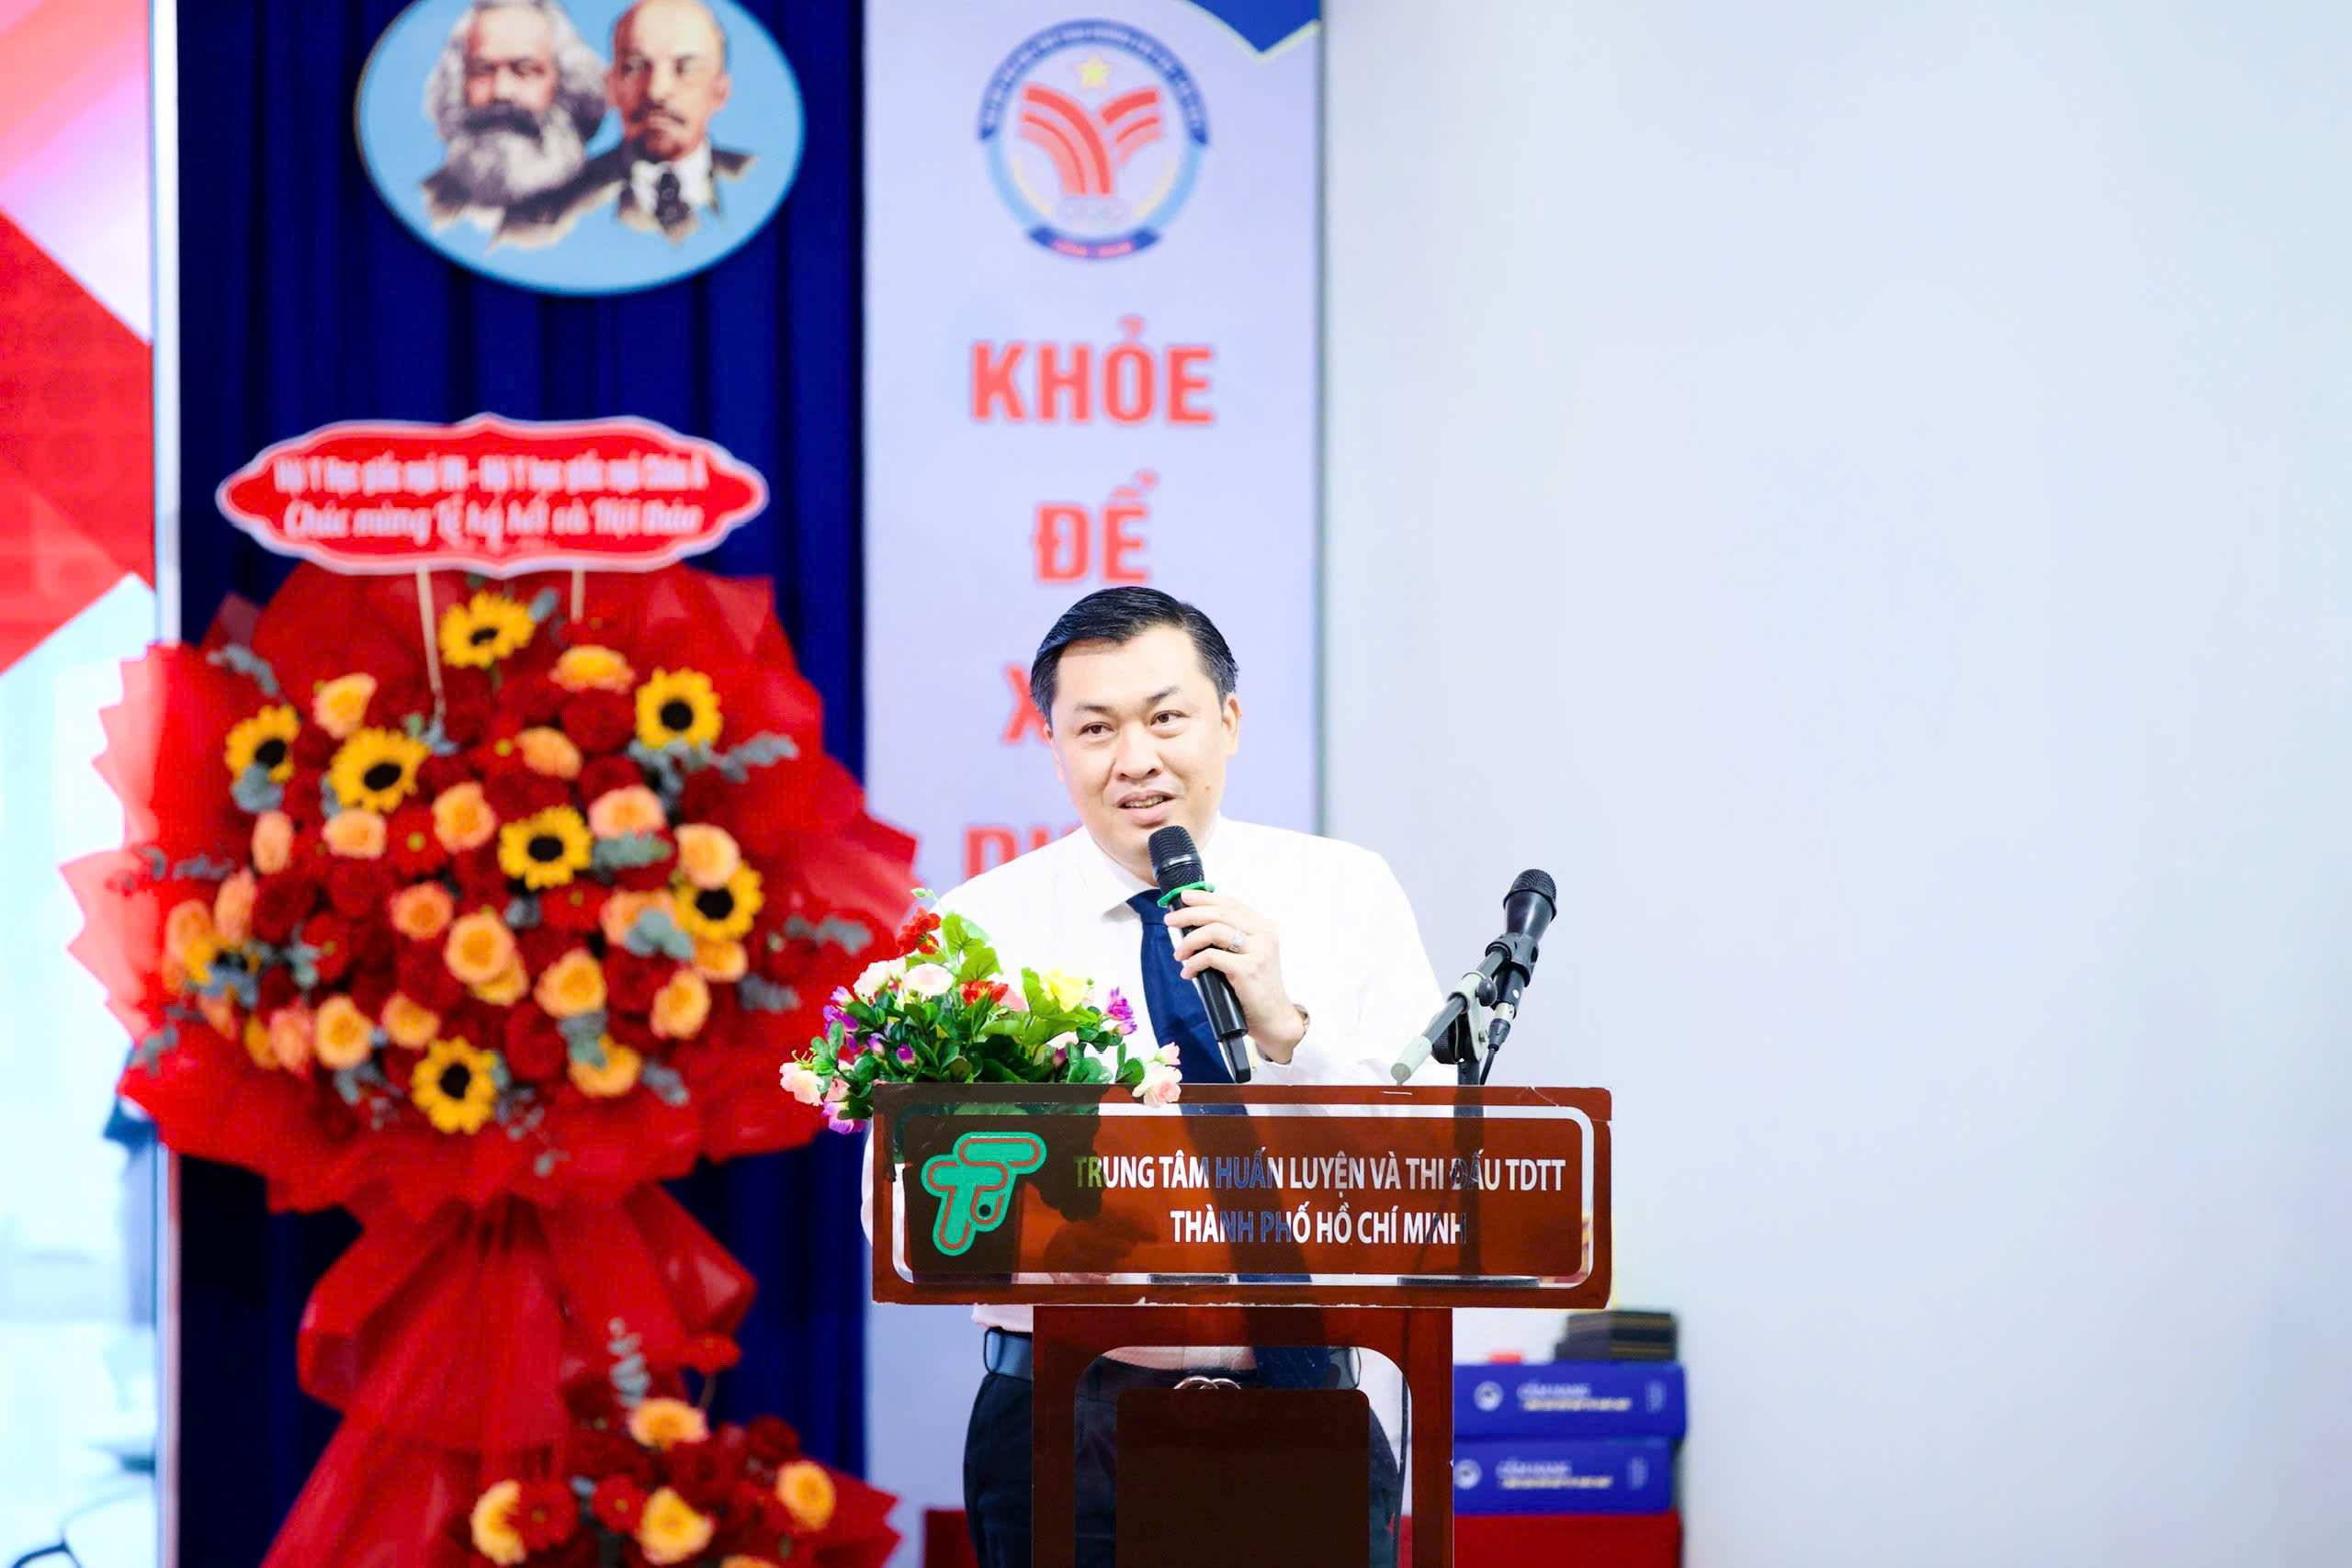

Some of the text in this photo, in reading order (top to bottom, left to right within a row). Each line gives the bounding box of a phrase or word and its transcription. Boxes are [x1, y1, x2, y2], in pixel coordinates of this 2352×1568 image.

[973, 316, 1212, 423] KHỎE
[1035, 471, 1159, 581] ĐỂ
[1073, 1156, 1155, 1188] TRUNG
[1159, 1149, 1209, 1188] TÂM
[1215, 1146, 1283, 1189] HUẤN
[1290, 1150, 1364, 1199] LUYỆN
[1370, 1150, 1401, 1190] VÀ
[1406, 1157, 1443, 1190] THI
[1505, 1158, 1566, 1190] TDTT
[1170, 1201, 1466, 1244] THÀNH PHỐ HỒ CHÍ MINH
